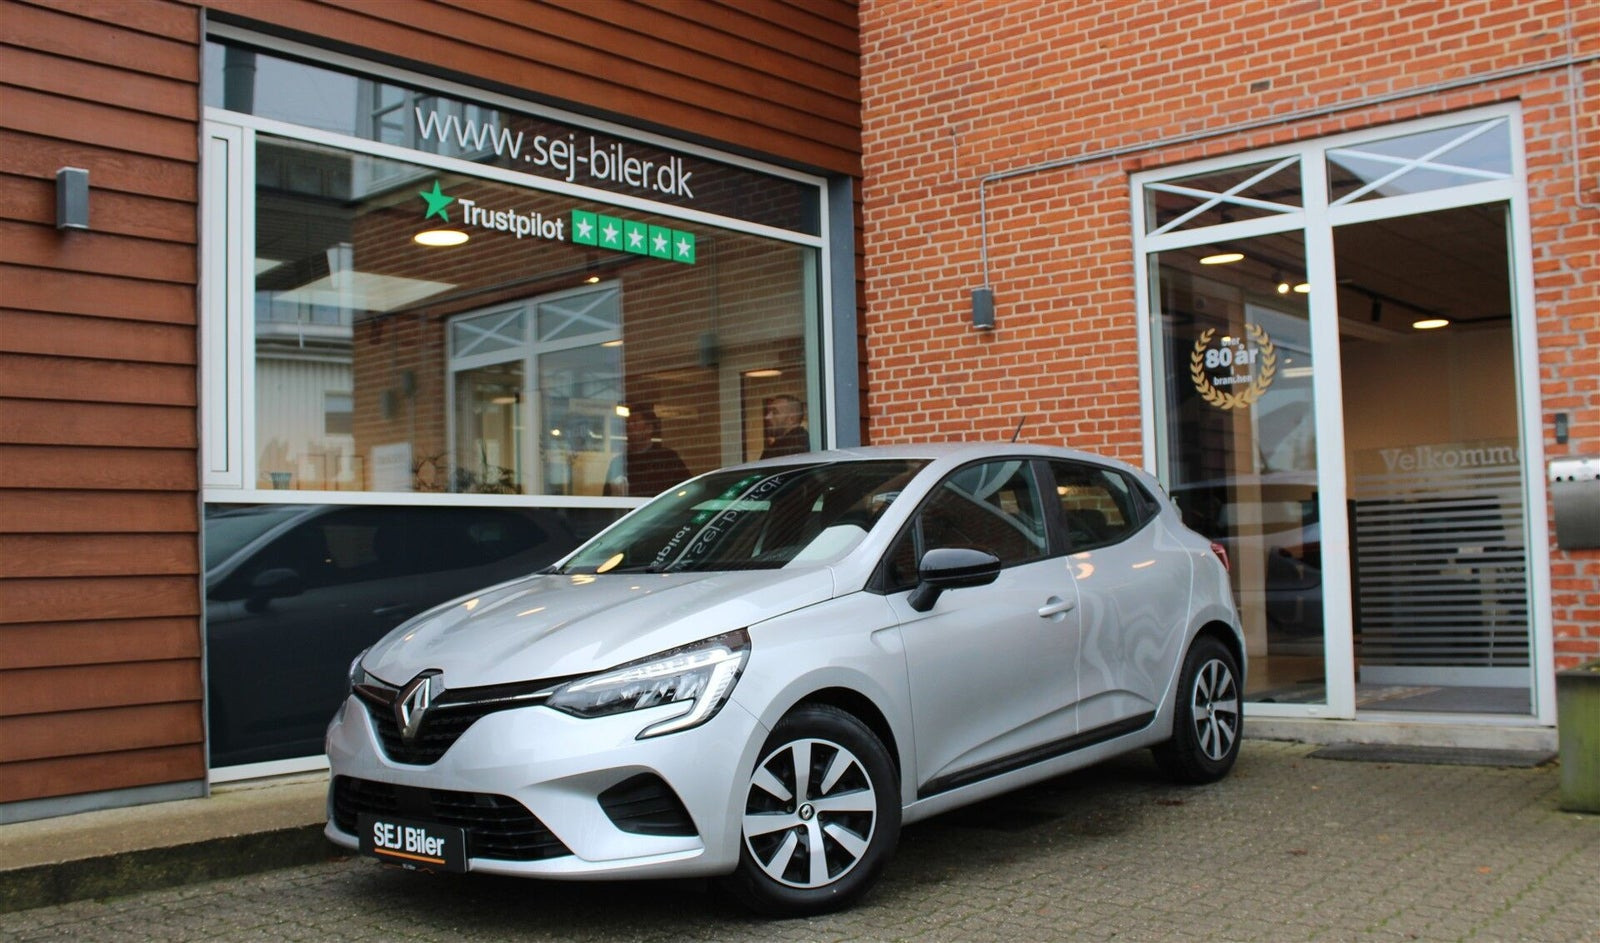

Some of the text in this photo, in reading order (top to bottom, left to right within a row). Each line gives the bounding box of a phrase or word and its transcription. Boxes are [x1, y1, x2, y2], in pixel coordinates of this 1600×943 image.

[415, 106, 694, 198] www.sej-biler.dk
[458, 198, 565, 241] Trustpilot
[1205, 343, 1258, 367] 80 år
[1213, 375, 1252, 385] branchen
[373, 821, 445, 857] SEJ Biler
